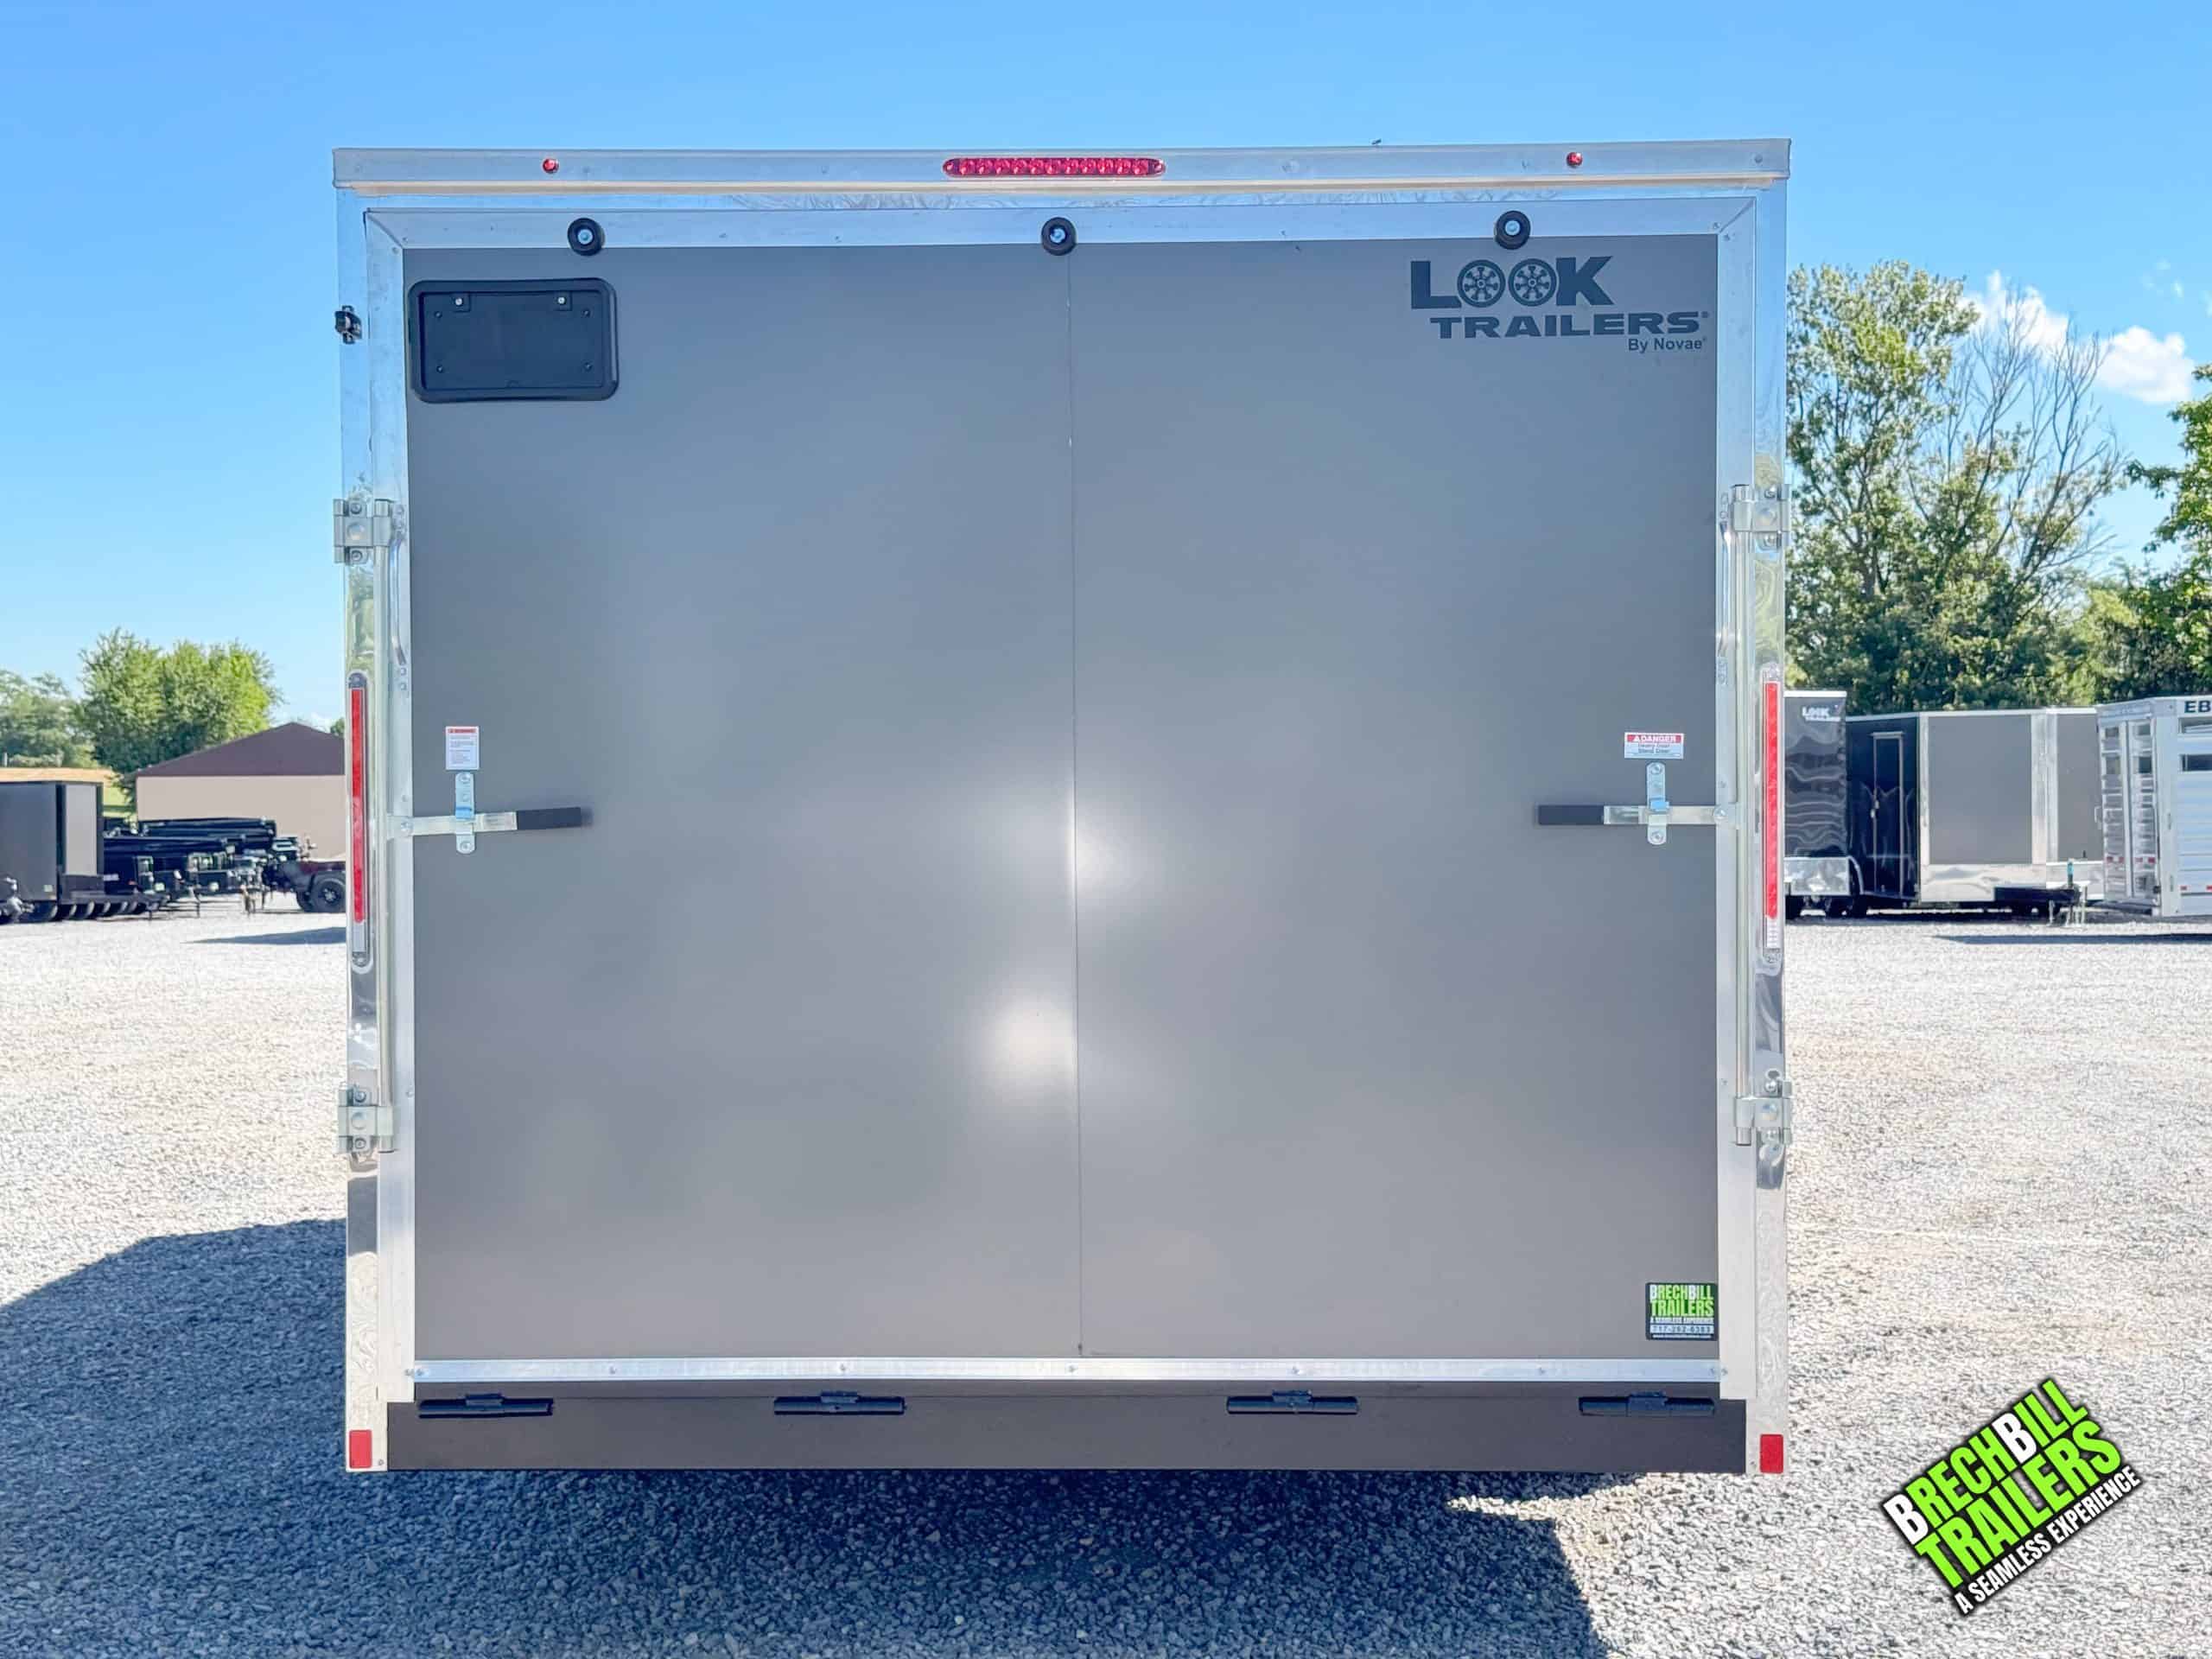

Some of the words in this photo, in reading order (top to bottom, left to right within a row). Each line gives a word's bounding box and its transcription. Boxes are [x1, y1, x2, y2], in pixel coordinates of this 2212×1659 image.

[1410, 256, 1614, 309] LOOK
[1430, 312, 1700, 339] TRAILERS
[1628, 338, 1648, 353] By
[1654, 337, 1702, 351] Novae
[1649, 1284, 1713, 1300] BRECHBILL
[1650, 1300, 1714, 1317] TRAILERS
